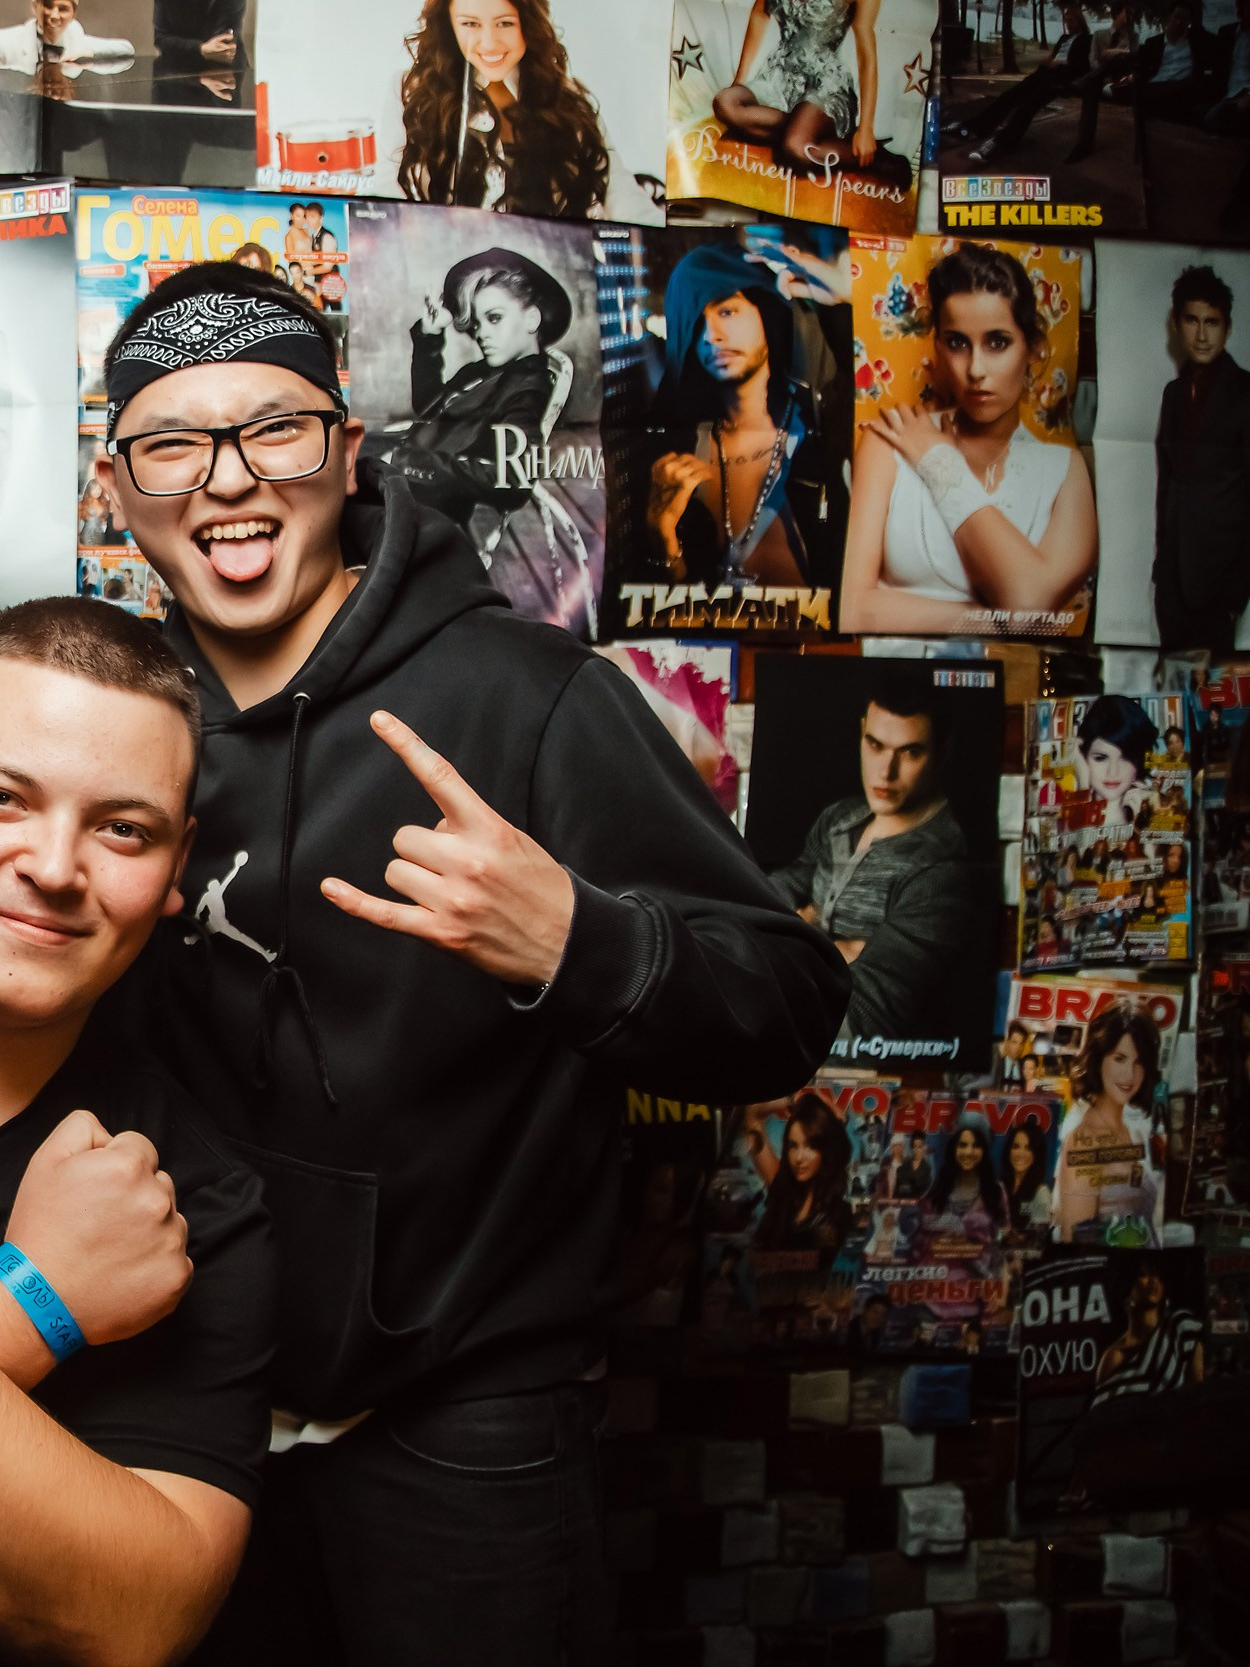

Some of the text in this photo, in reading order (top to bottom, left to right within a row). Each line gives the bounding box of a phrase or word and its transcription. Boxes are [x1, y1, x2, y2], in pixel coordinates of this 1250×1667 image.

[257, 168, 313, 186] Майли
[804, 144, 905, 226] Spears
[133, 197, 197, 215] Селена
[944, 204, 1103, 227] THE KILLERS
[77, 195, 280, 262] Гомес
[620, 583, 832, 632] ТИМАТИ
[1013, 611, 1075, 625] ФУРТАДО
[852, 1034, 960, 1060] («Сумерки»)
[862, 1264, 950, 1282] легкие
[1022, 1283, 1112, 1328] ОНА
